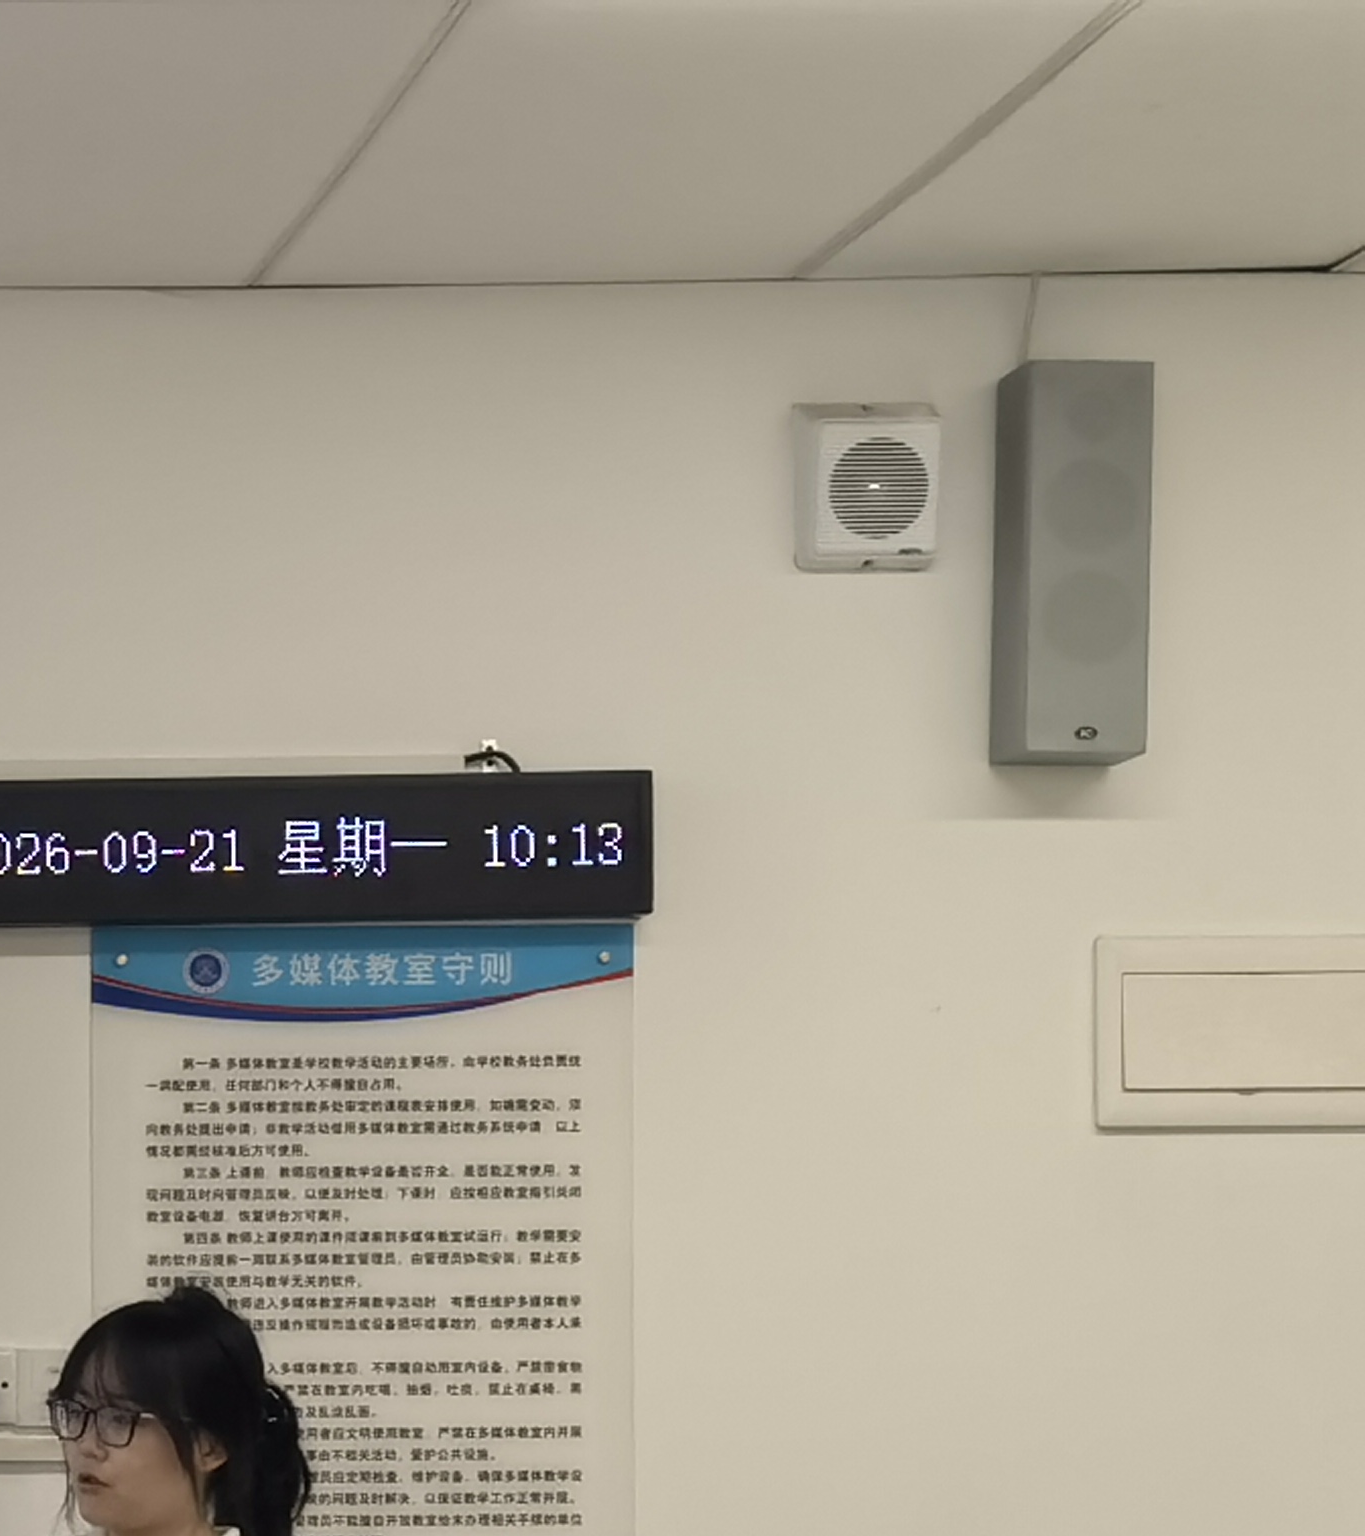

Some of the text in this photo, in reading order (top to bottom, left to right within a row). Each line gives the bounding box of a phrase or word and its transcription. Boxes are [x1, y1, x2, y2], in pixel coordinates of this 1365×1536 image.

[277, 816, 449, 877] 星期一
[483, 822, 623, 868] 10:13
[251, 951, 513, 987] 多媒体教室守则
